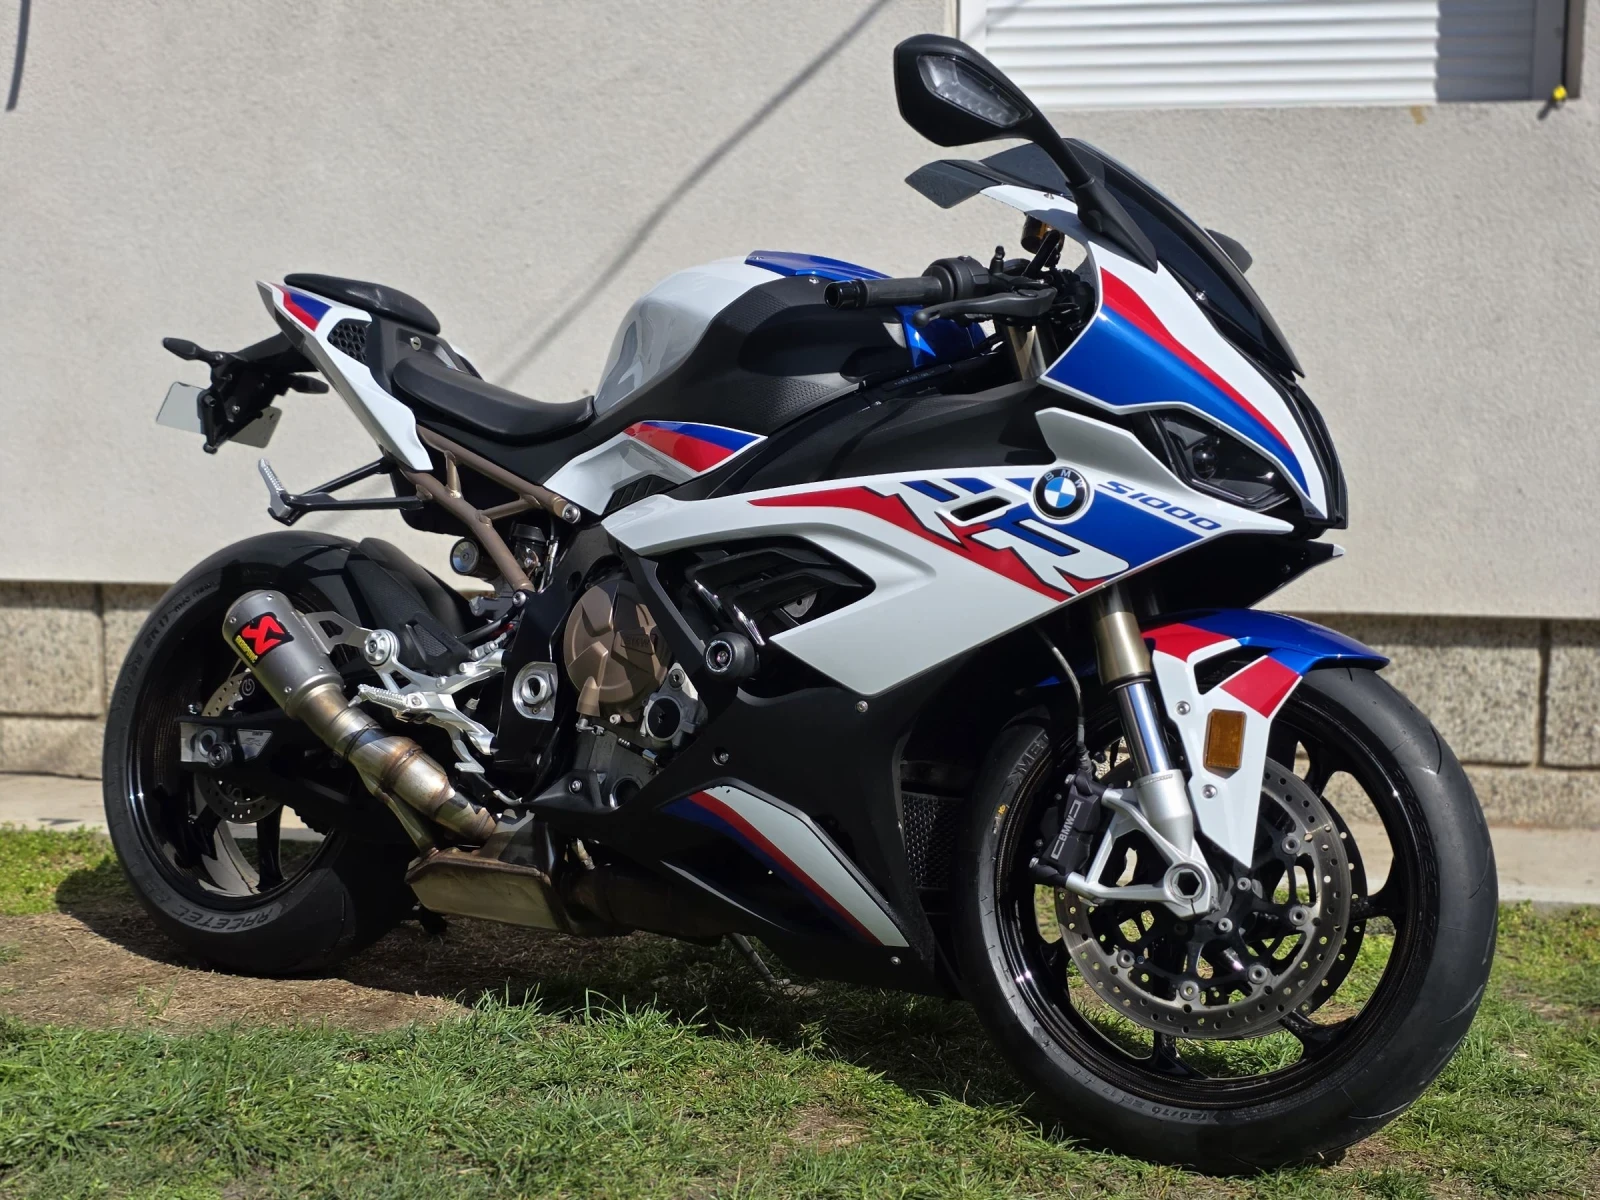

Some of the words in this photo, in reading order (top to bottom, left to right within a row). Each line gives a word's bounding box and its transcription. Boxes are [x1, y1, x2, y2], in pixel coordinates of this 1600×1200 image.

[1044, 469, 1083, 488] BMW
[1098, 480, 1222, 531] S1000
[1058, 814, 1075, 842] BMW
[171, 904, 274, 930] RACETEC
